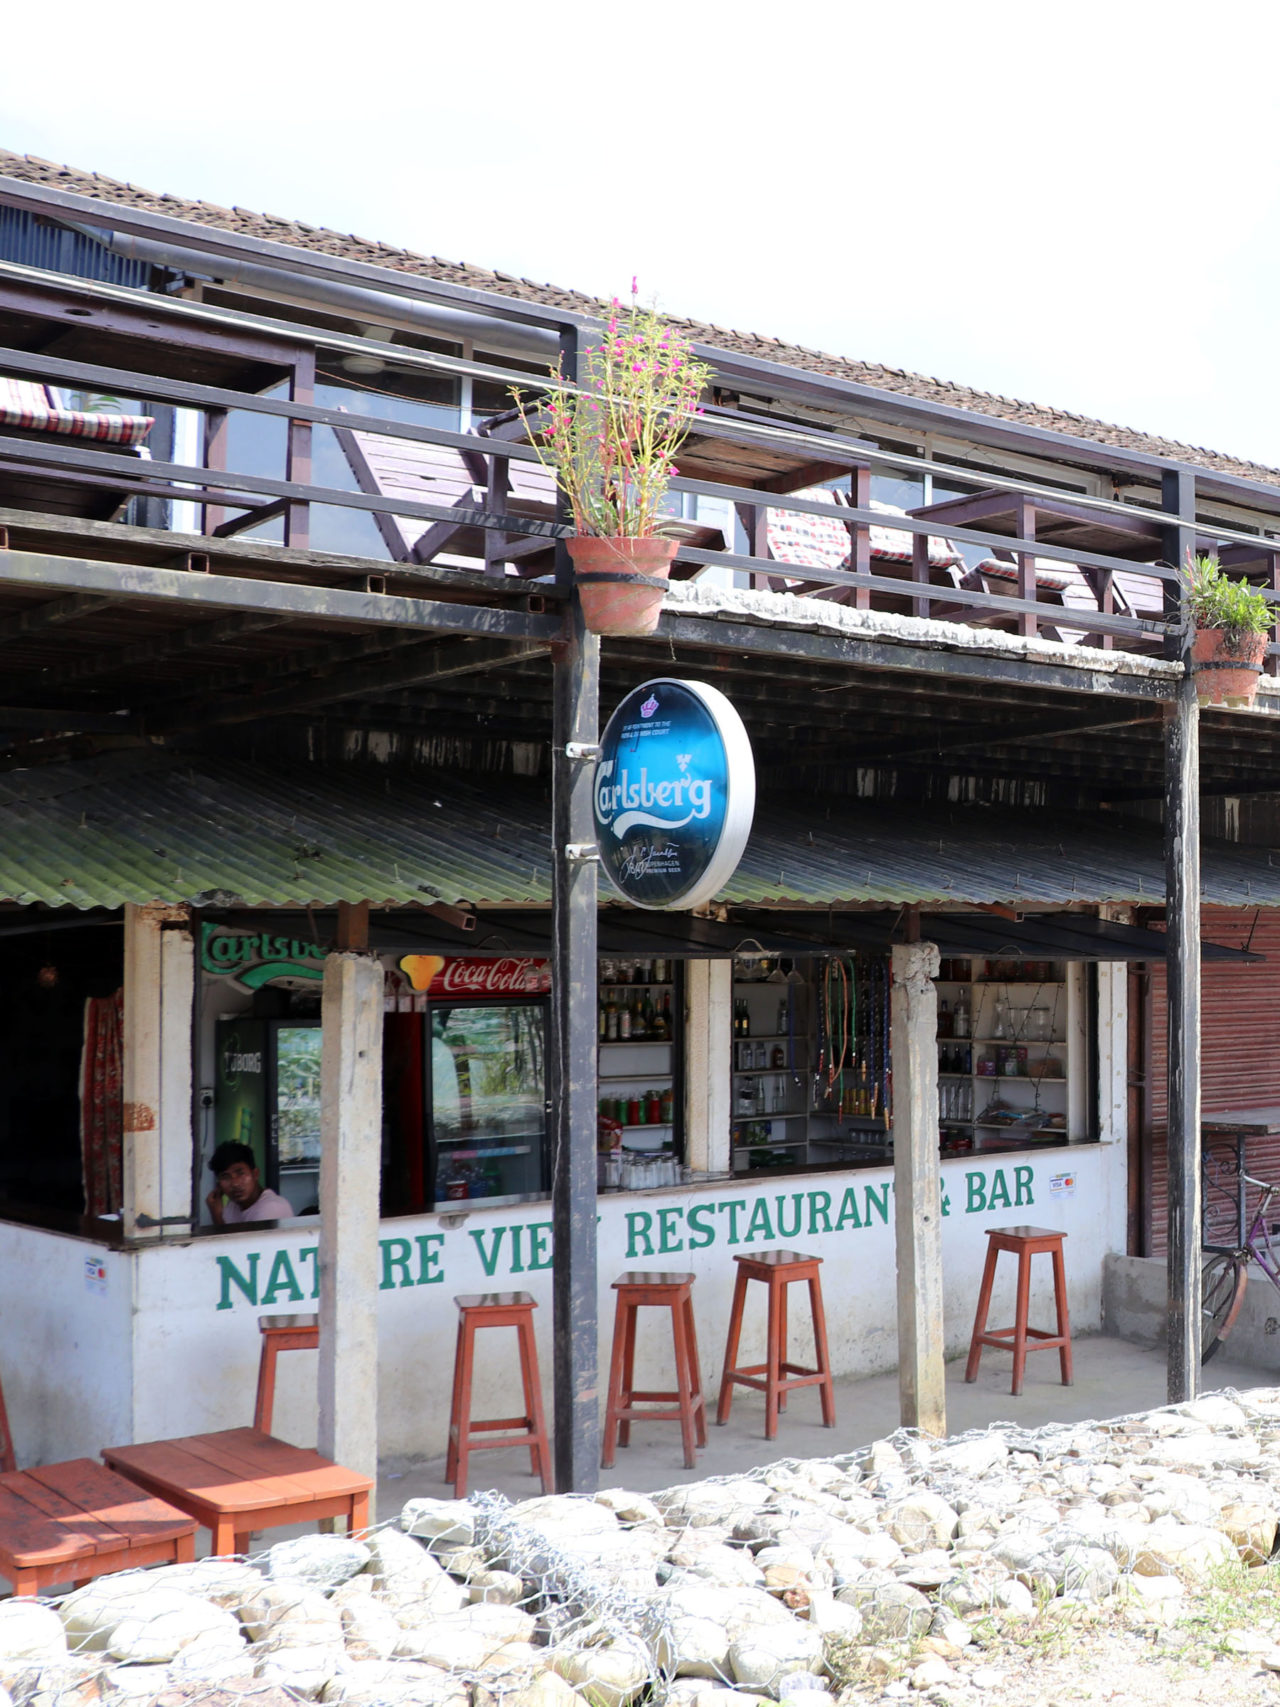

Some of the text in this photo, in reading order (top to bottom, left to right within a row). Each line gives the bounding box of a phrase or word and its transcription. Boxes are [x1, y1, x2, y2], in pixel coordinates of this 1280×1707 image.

[595, 758, 713, 825] Carlsberg
[443, 958, 534, 991] Coca-Cola
[216, 1233, 445, 1310] NATRE
[469, 1215, 602, 1276] VIE
[624, 1182, 895, 1258] RESTAURAN
[964, 1165, 1035, 1214] BAR
